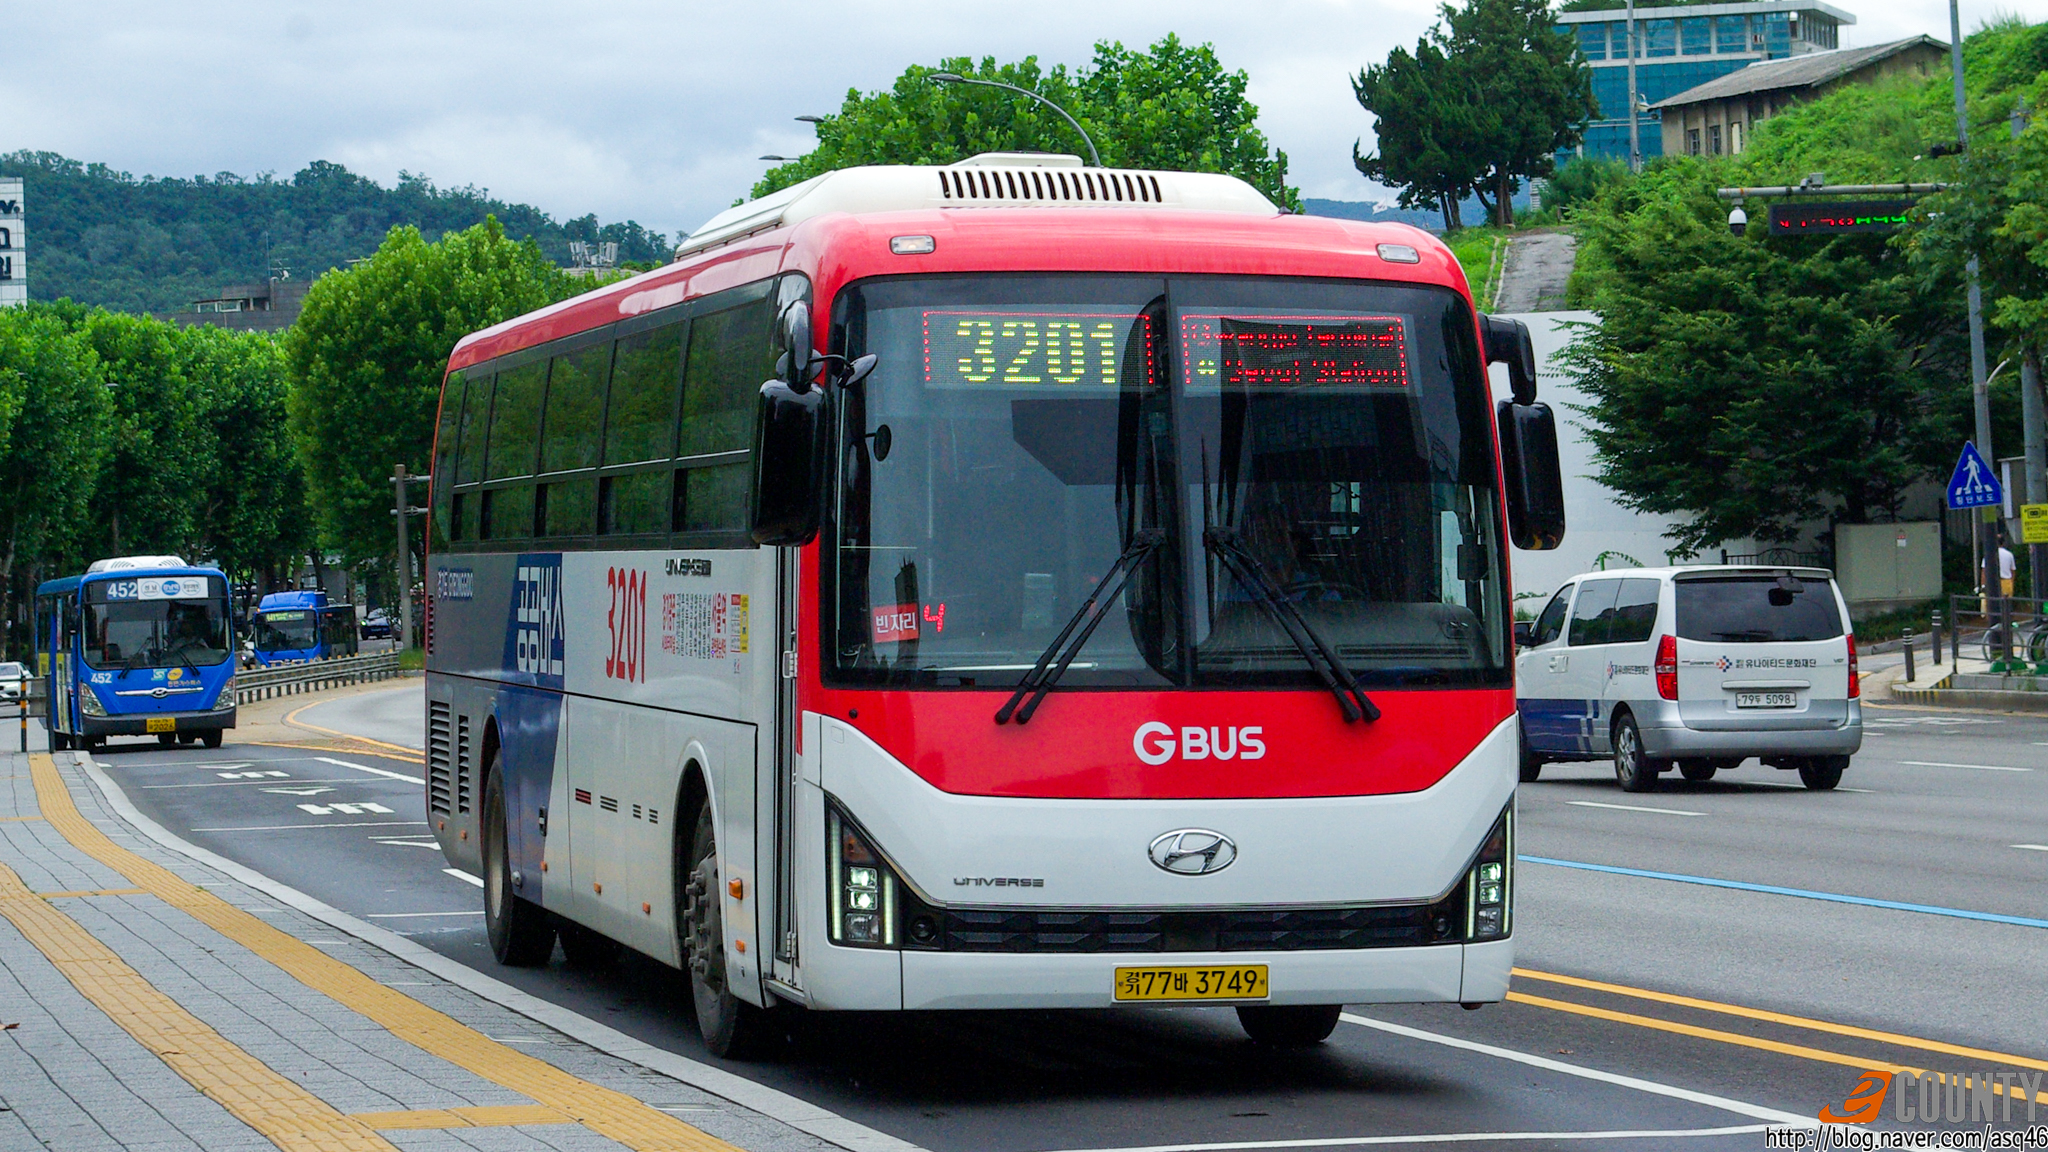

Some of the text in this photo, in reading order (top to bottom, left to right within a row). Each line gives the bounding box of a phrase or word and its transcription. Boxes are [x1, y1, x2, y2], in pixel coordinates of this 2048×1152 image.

[957, 321, 1116, 384] 3201
[1224, 360, 1301, 383] Seoul
[108, 582, 138, 598] 452
[606, 566, 646, 685] 3201
[875, 603, 945, 633] 빈자리 4
[1745, 658, 1817, 669] 유나이티드문화재단
[91, 672, 113, 684] 452
[1766, 694, 1791, 705] 5098
[953, 876, 1045, 888] UNIVERSE
[1195, 970, 1257, 995] 3749
